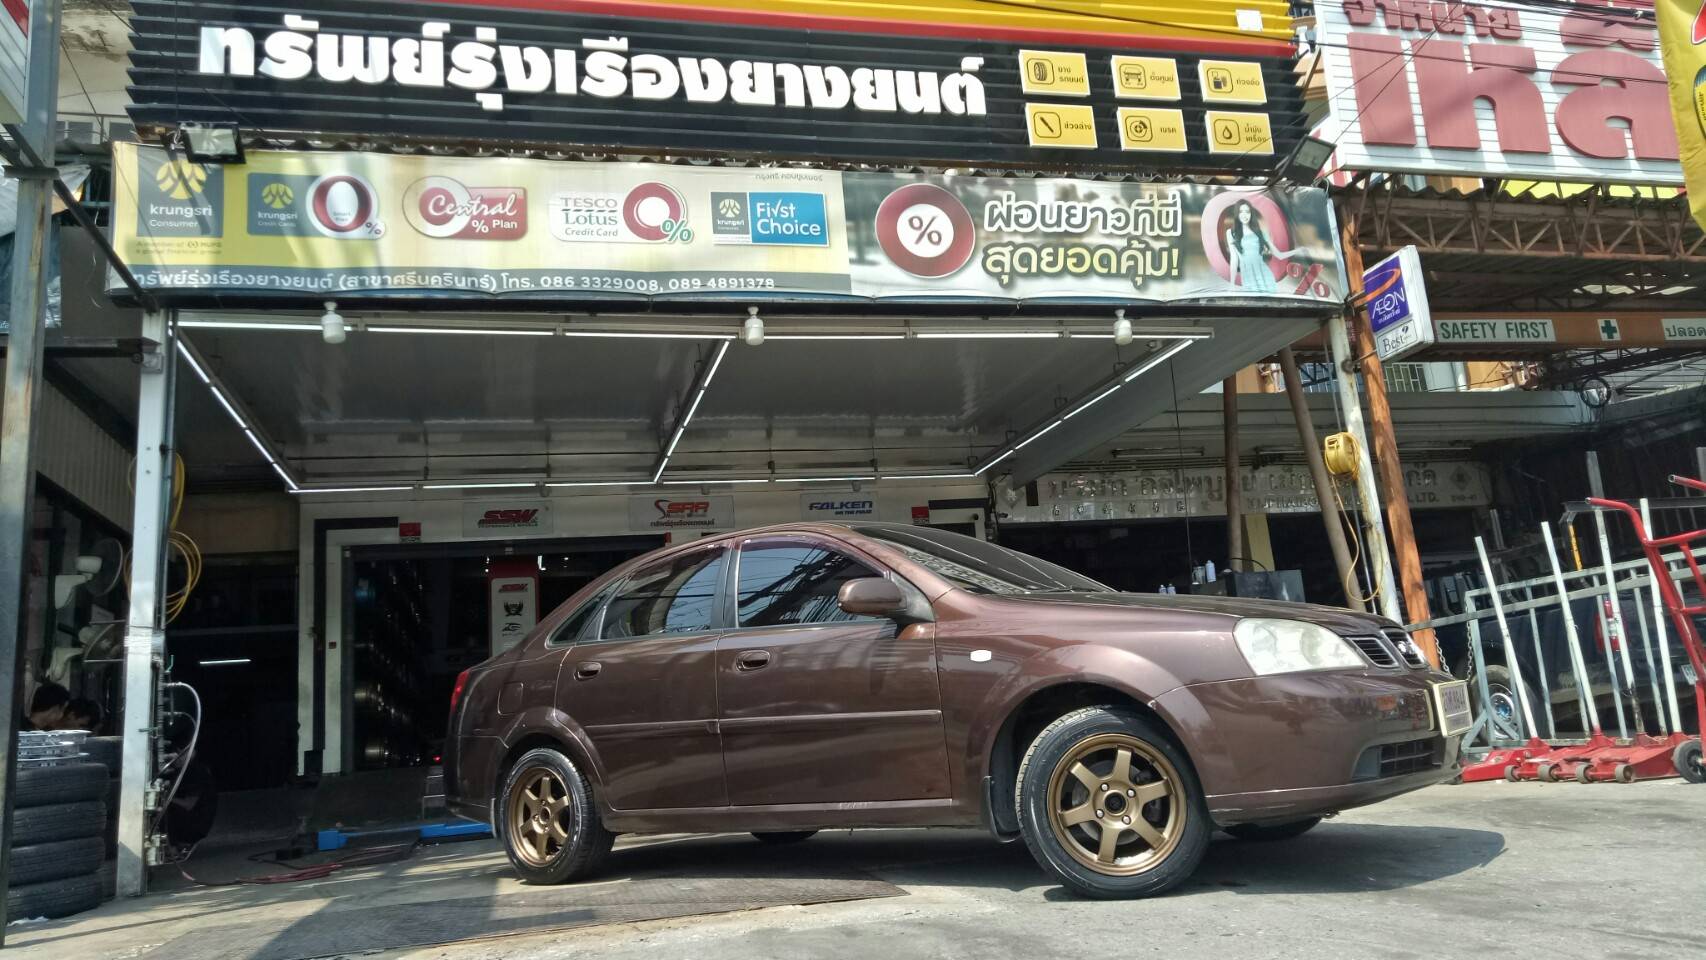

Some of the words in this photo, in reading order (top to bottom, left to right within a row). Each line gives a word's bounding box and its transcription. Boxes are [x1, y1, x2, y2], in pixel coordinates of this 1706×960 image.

[199, 14, 987, 115] ทรัพย์รุ่งเรืองยางยนต์
[428, 193, 518, 217] Central
[560, 197, 618, 208] TESCO
[150, 204, 212, 217] krungsri
[257, 211, 298, 221] krungsri
[986, 192, 1182, 235] ผ่อนยาวที่นี่
[150, 219, 199, 228] Consumer
[492, 219, 518, 229] Plan
[564, 212, 618, 226] Lotus
[564, 227, 593, 237] Credit
[596, 228, 618, 237] Card
[756, 218, 821, 236] Choice
[984, 240, 1179, 285] สุดยอดคุ้ม!
[501, 272, 535, 289] โทร.
[540, 276, 575, 288] 086
[668, 277, 701, 290] 089
[707, 277, 775, 289] 4891378
[1440, 322, 1497, 339] SAFETY
[1506, 321, 1549, 339] FIRST
[808, 500, 873, 510] FALKEN
